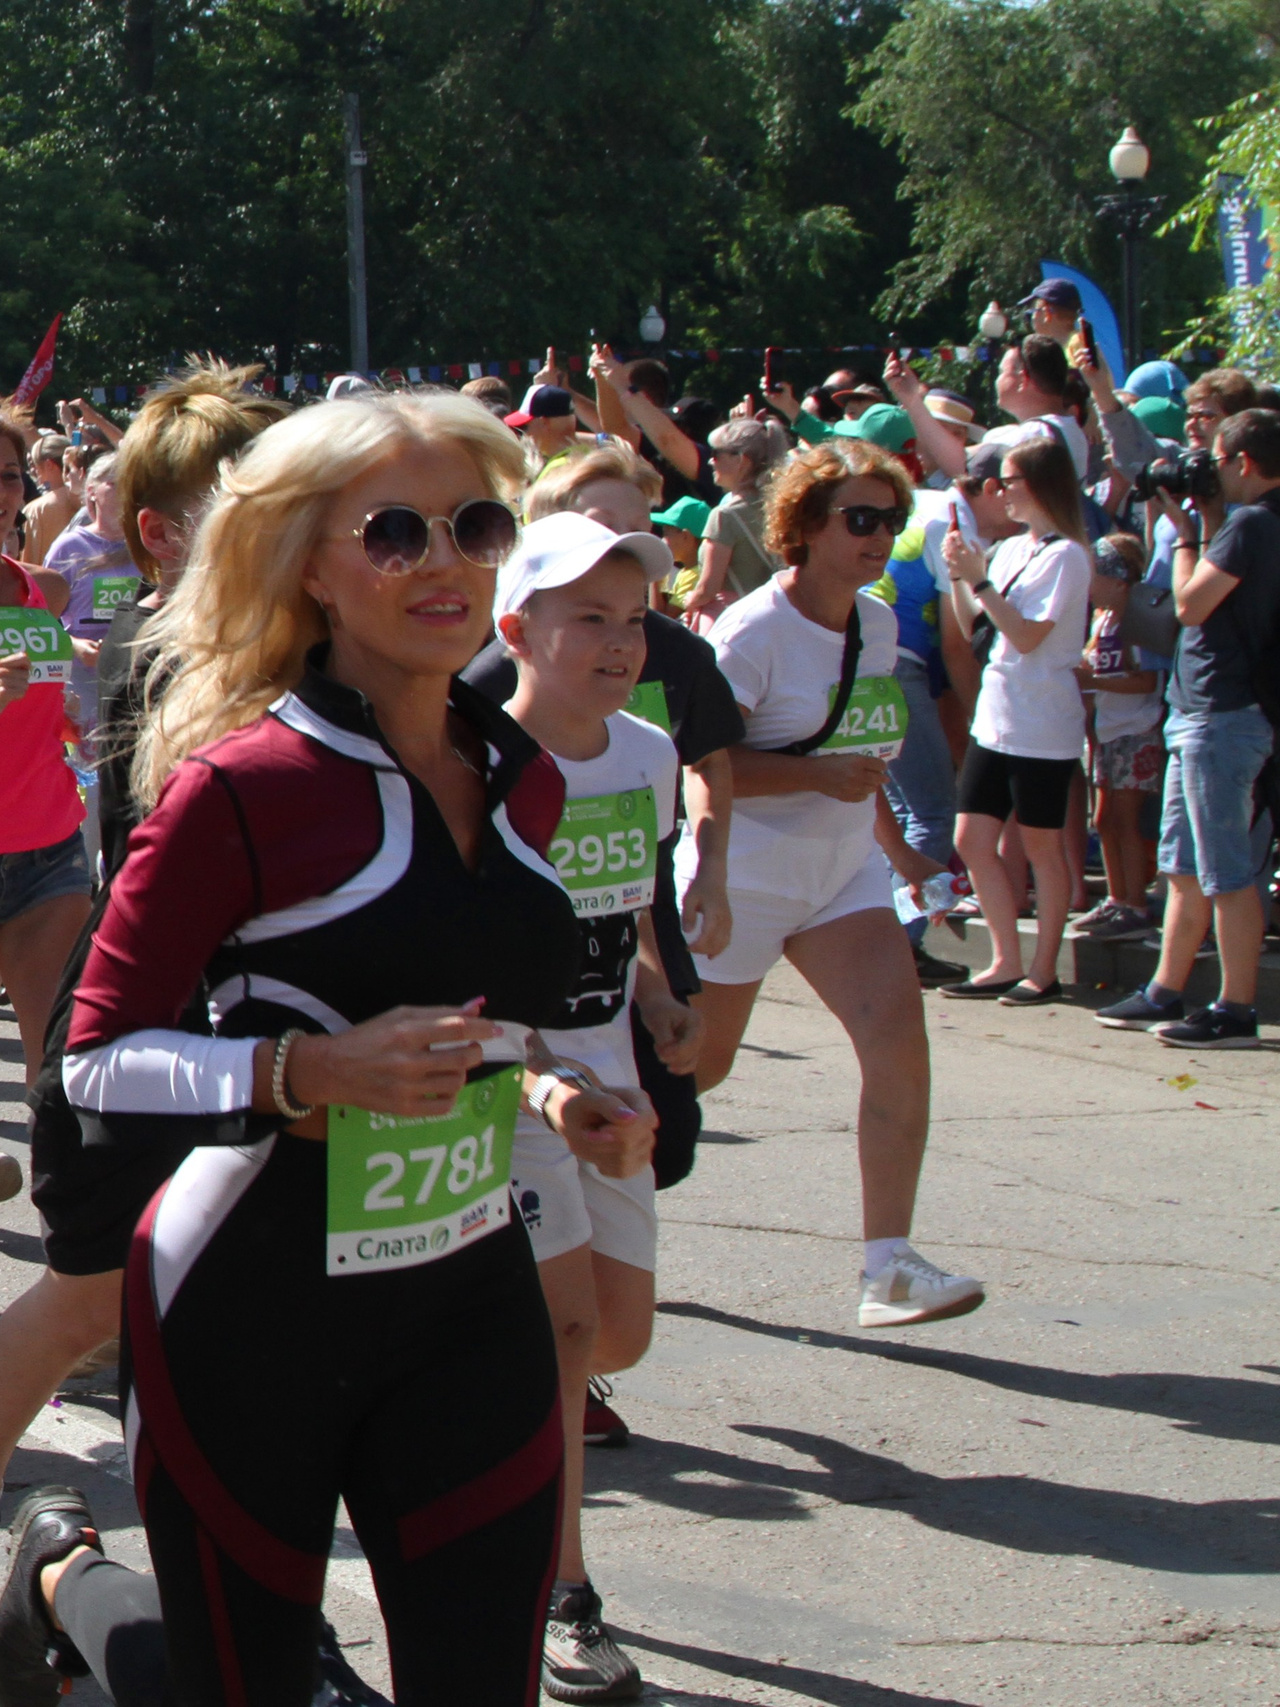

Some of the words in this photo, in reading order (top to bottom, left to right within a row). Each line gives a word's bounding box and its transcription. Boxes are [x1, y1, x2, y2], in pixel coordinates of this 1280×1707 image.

[835, 703, 899, 738] 4241
[550, 828, 646, 878] 2953
[364, 1123, 495, 1211] 2781
[356, 1234, 427, 1261] Слата
